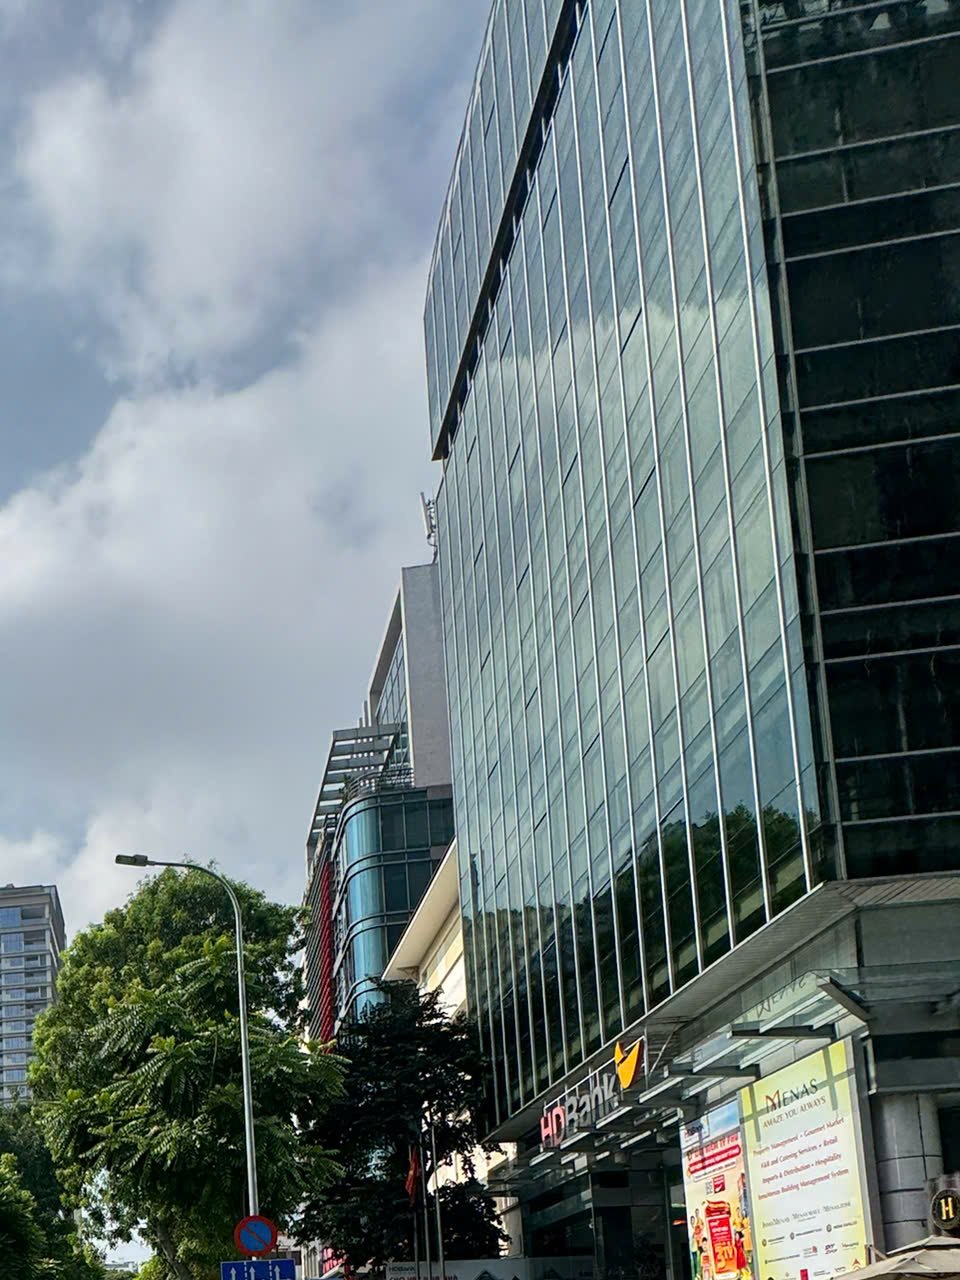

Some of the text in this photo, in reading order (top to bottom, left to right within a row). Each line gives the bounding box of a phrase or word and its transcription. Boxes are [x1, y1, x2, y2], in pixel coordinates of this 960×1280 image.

[541, 1073, 619, 1147] HDBank
[765, 1078, 818, 1113] MENAS
[763, 1115, 783, 1128] AMAZE
